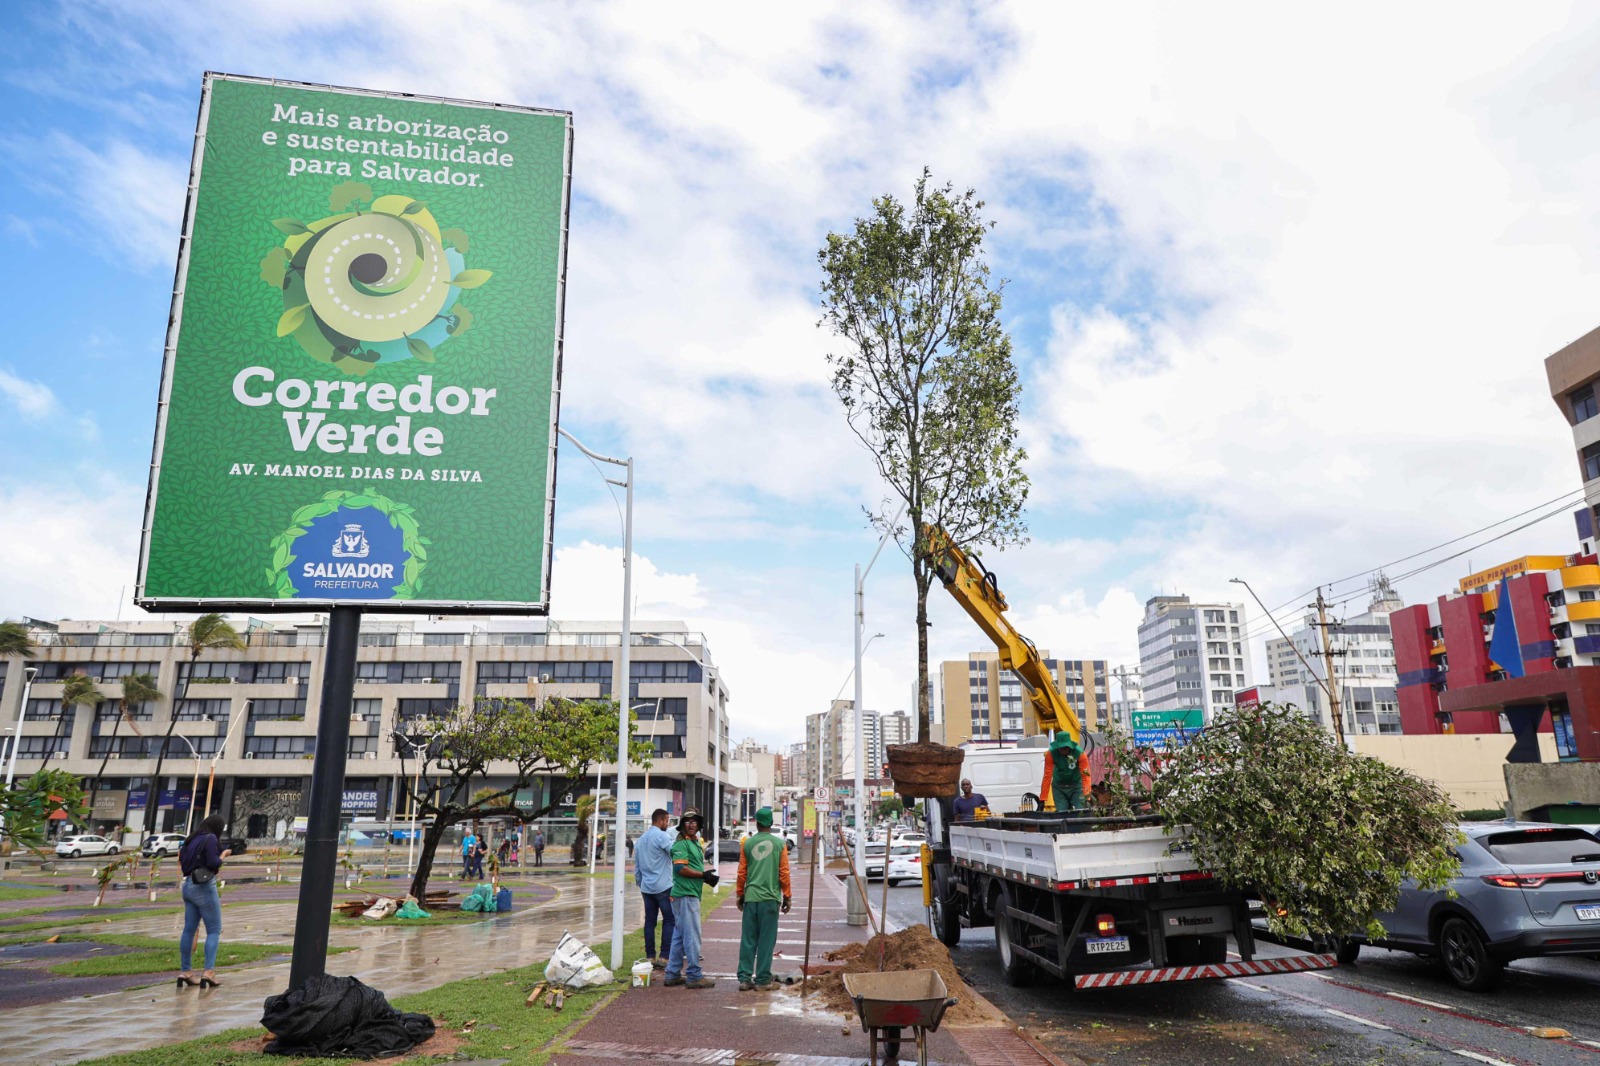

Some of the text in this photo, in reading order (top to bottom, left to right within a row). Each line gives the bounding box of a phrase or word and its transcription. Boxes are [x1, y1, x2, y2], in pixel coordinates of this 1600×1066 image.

[271, 103, 509, 146] Mais arborização
[262, 130, 514, 167] e sustentabilidade
[288, 157, 484, 188] para Salvador.
[232, 366, 497, 416] Corredor
[282, 411, 444, 457] Verde
[229, 463, 483, 483] AV. MANOEL DIAS DA SILVA
[302, 562, 394, 579] SALVADOR
[314, 580, 379, 589] PREFEITURA
[1464, 576, 1484, 588] HOTEL
[342, 792, 377, 800] ANDER
[1091, 942, 1126, 952] RTP2E25
